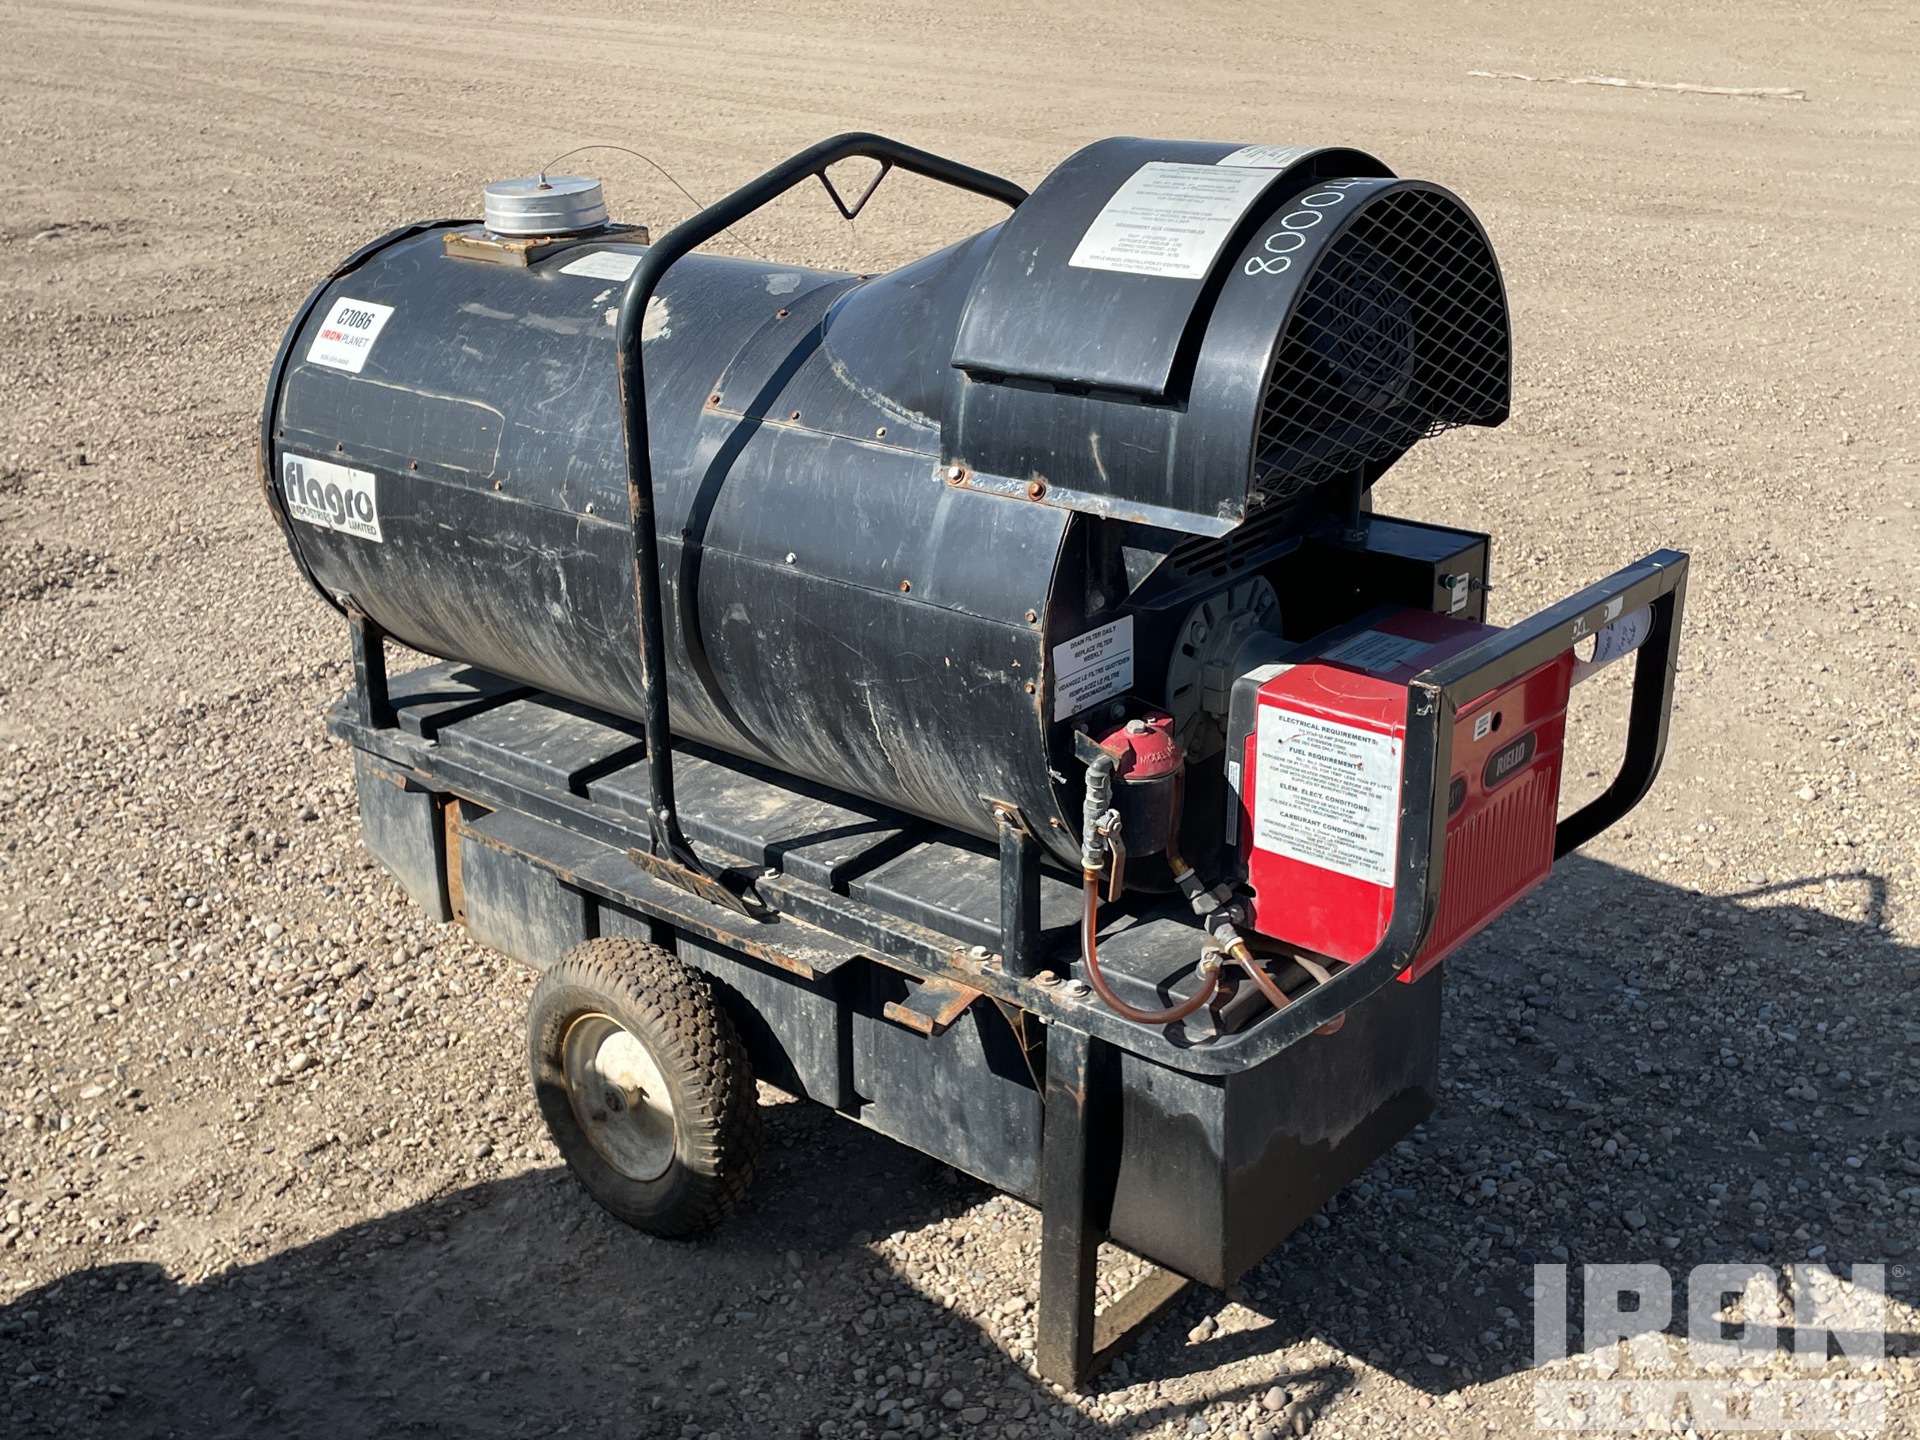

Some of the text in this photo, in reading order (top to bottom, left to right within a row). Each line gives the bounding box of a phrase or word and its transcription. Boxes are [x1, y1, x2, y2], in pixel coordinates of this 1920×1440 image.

[337, 308, 375, 330] C7086
[285, 461, 374, 525] flagro
[290, 503, 332, 523] INDUSTRIES
[348, 519, 377, 536] LIMITED
[1070, 624, 1116, 649] DRAIN FILTER DAILY
[1073, 636, 1112, 659] REPLACE FILTER
[1083, 648, 1103, 662] WEEKLY
[1081, 673, 1087, 681] LE
[1088, 666, 1103, 678] FILTRE
[1278, 714, 1319, 730] ELECTRICAL
[1289, 746, 1306, 756] FUEL
[1496, 742, 1525, 777] RIELLO
[1279, 782, 1299, 793] ELEM.
[1279, 810, 1320, 827] CARBURANT
